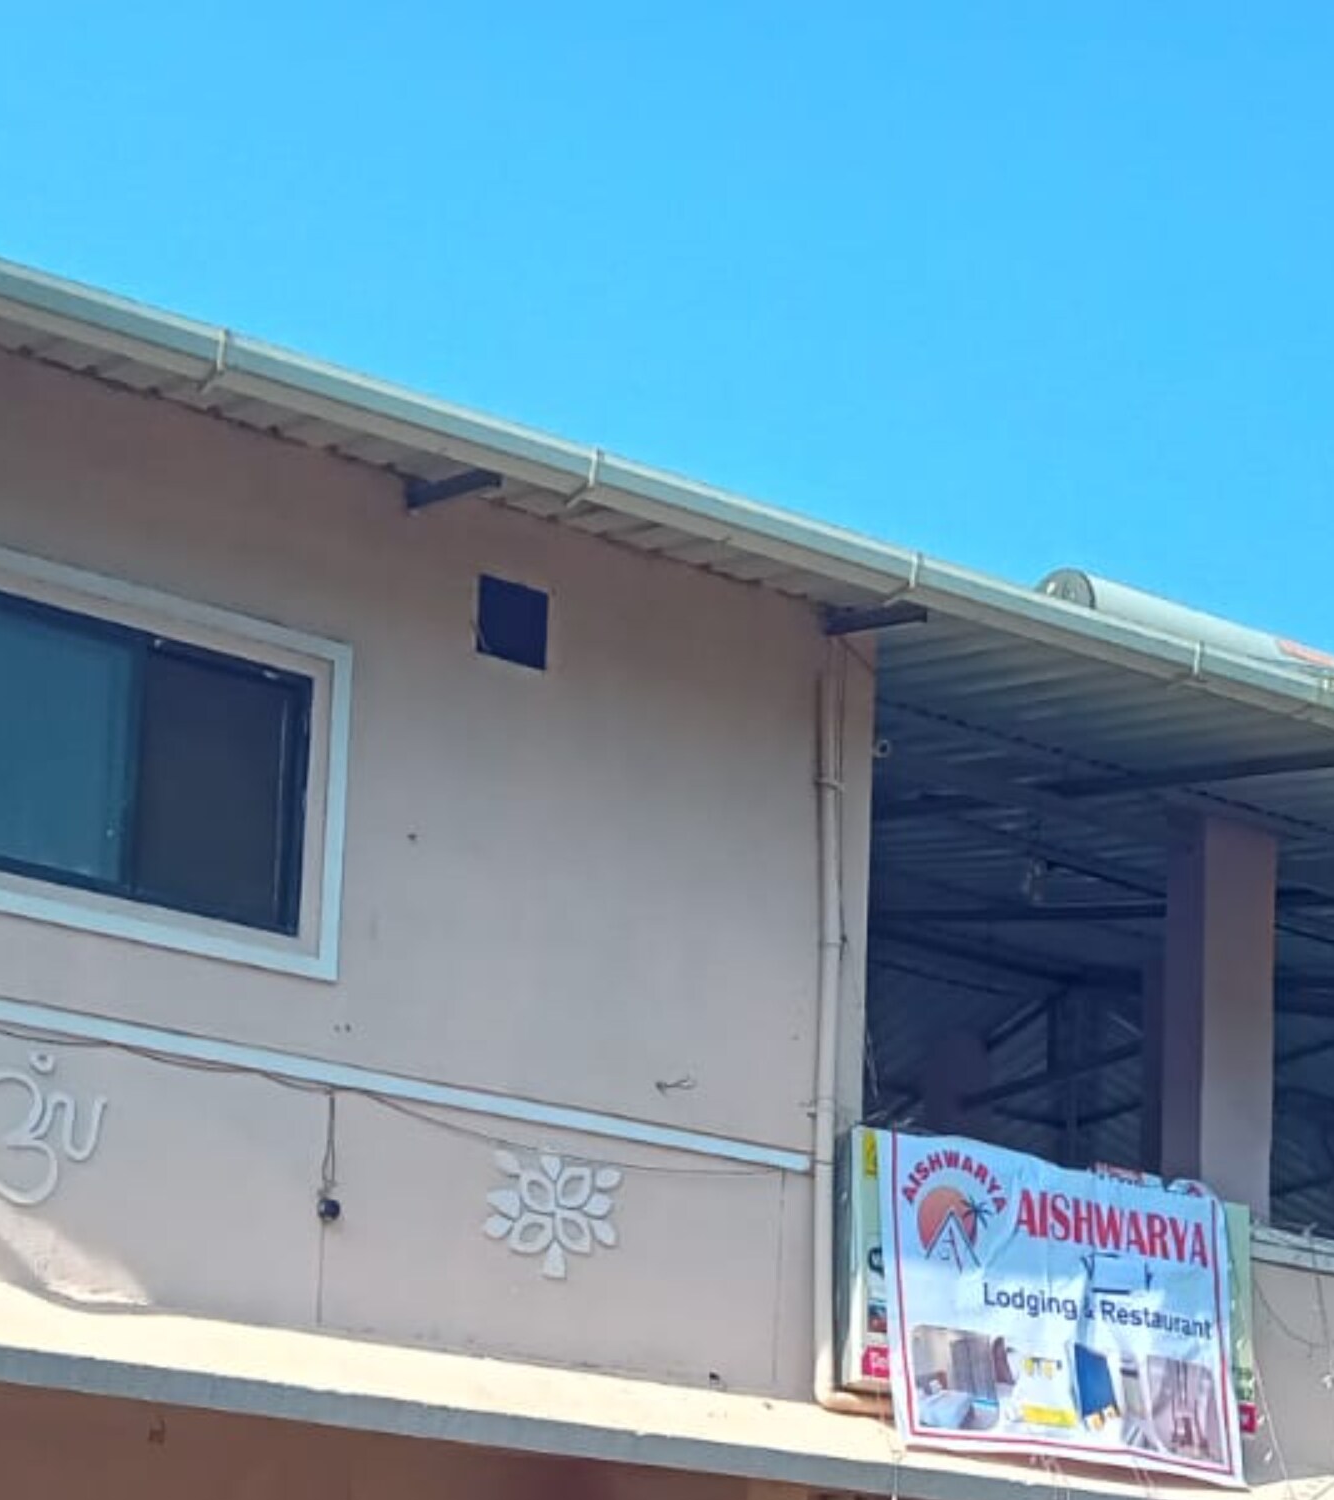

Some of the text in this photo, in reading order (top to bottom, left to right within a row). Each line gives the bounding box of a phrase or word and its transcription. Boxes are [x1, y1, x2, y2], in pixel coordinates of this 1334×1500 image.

[901, 1148, 1008, 1215] AISHWARYA
[1016, 1188, 1209, 1269] AISHWARYA
[983, 1282, 1079, 1321] Lodging
[1100, 1299, 1212, 1340] Restaurant
